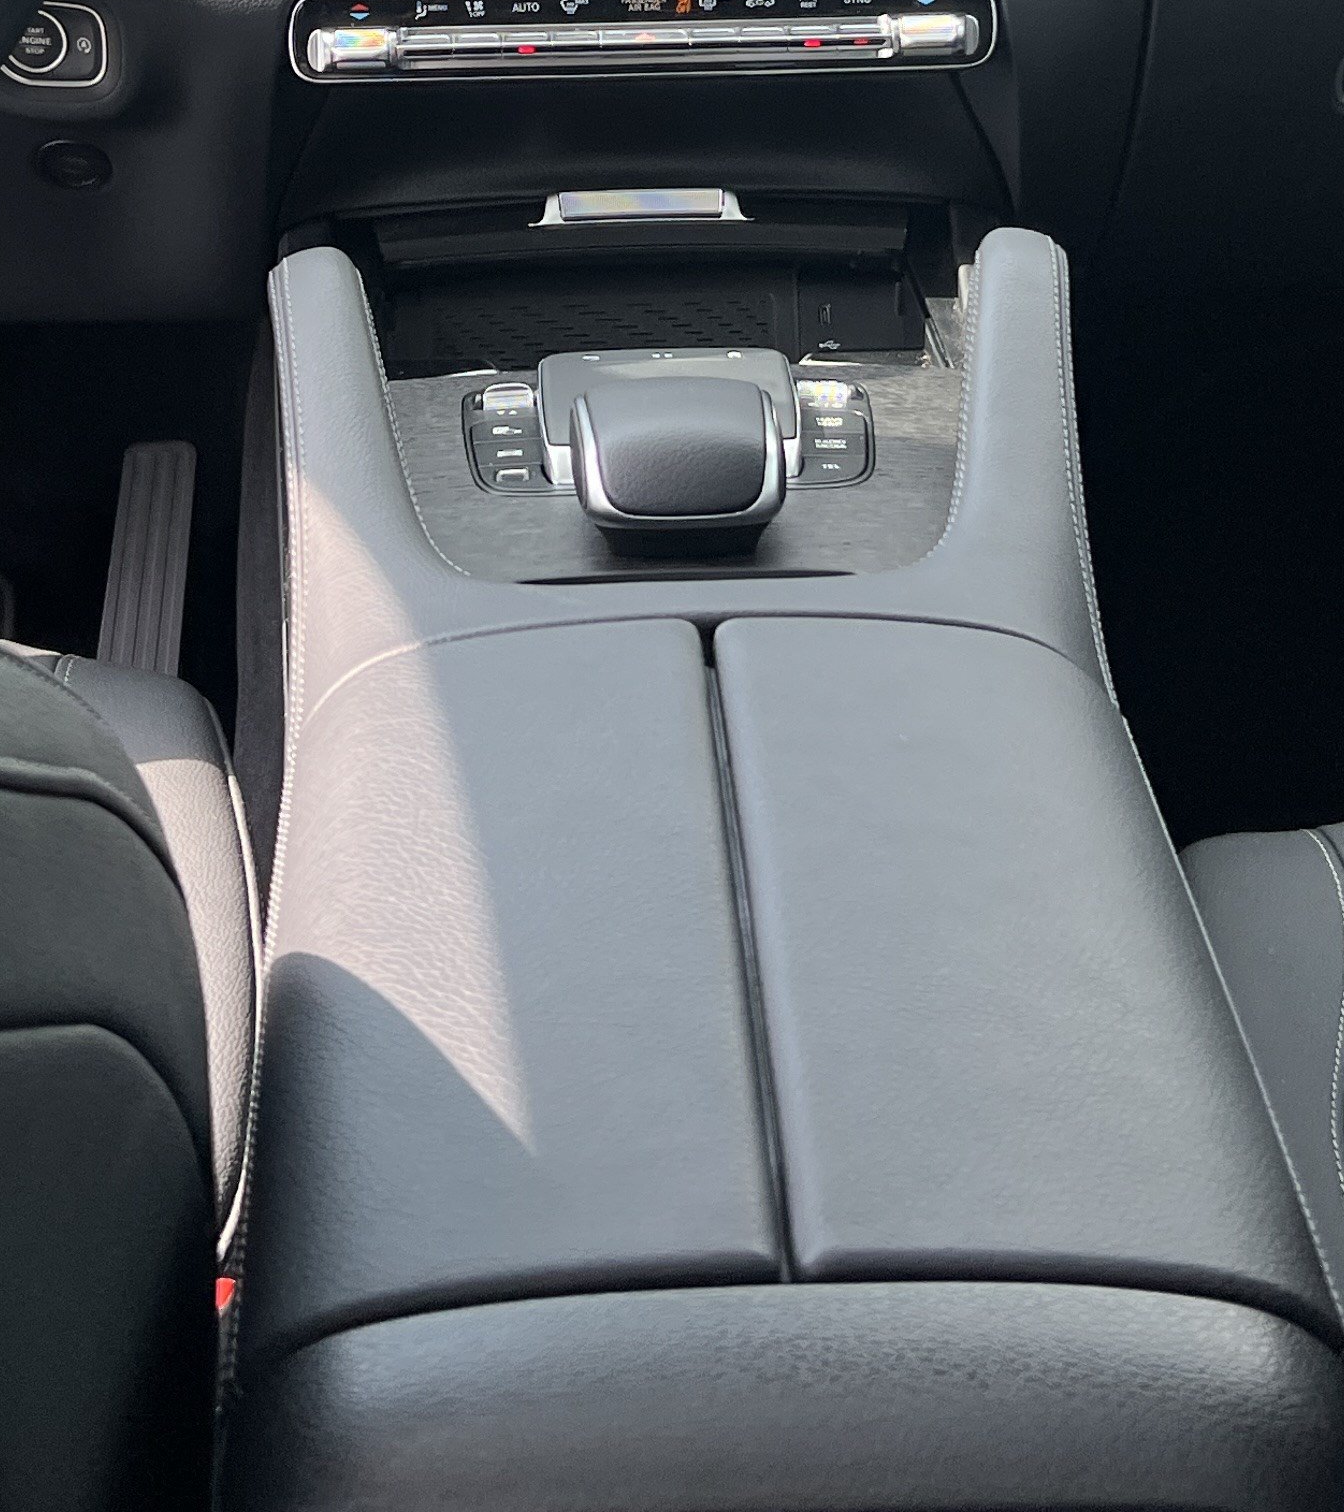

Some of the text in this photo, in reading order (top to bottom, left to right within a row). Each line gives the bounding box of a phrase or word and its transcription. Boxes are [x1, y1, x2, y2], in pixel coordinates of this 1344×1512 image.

[511, 1, 540, 13] AUTO
[627, 3, 661, 12] AIR BAG
[19, 36, 52, 46] NGINE
